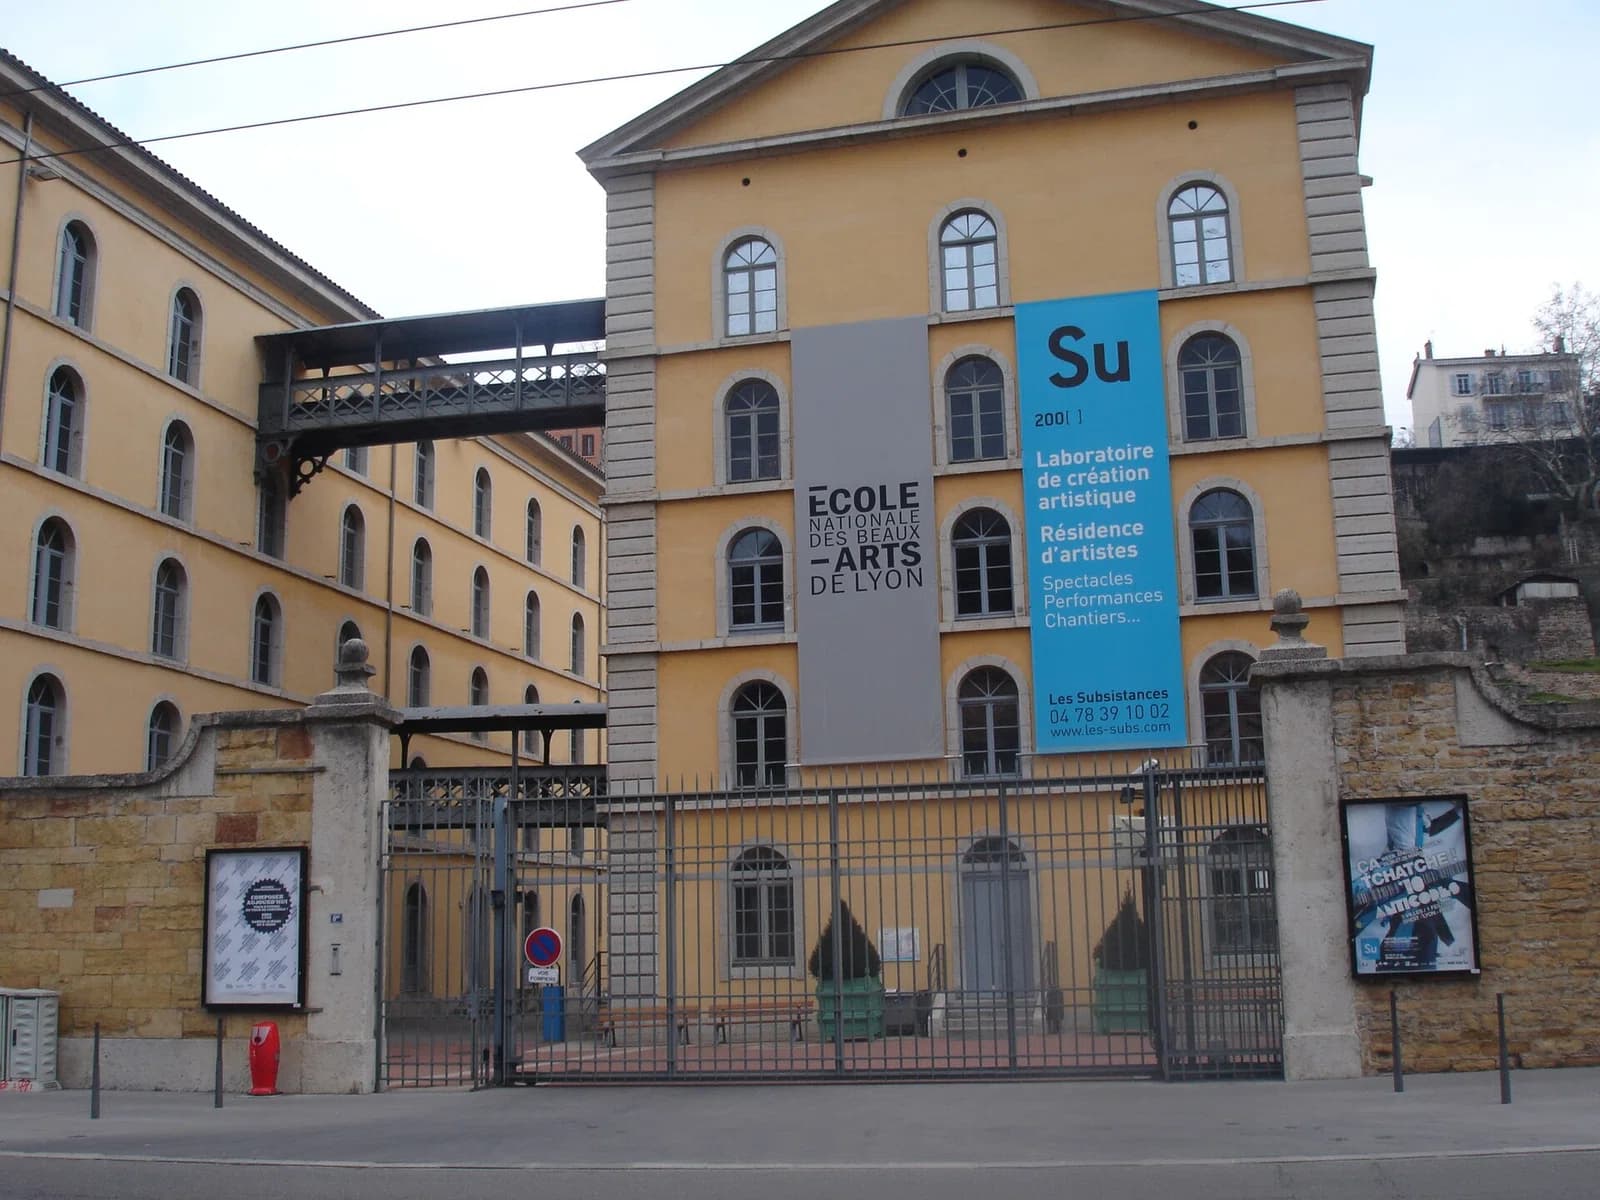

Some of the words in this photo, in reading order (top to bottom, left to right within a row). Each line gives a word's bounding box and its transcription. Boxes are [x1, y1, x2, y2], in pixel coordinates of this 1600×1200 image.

[1048, 325, 1130, 389] Su
[1036, 443, 1154, 468] Laboratoire
[1038, 471, 1062, 489] de
[1066, 466, 1149, 487] création
[1038, 489, 1137, 510] artistique
[809, 509, 921, 532] NATIONALE
[810, 530, 848, 548] DES
[857, 524, 920, 544] BEAUX
[1040, 521, 1144, 543] Résidence
[1041, 543, 1138, 564] d'artistes
[811, 573, 846, 596] DE
[855, 567, 923, 593] LYON
[1043, 571, 1134, 594] Spectacles
[1044, 589, 1163, 610] Performances
[1045, 609, 1141, 629] Chantiers...
[1049, 693, 1073, 706] Les
[1076, 689, 1169, 704] Subsistances
[1050, 709, 1069, 724] 04
[1074, 707, 1094, 722] 78
[1099, 705, 1119, 721] 39
[1125, 704, 1144, 720] 10
[1150, 703, 1169, 719] 02
[1050, 722, 1171, 737] www.les-subs.com
[1361, 852, 1449, 889] TCHATCHE
